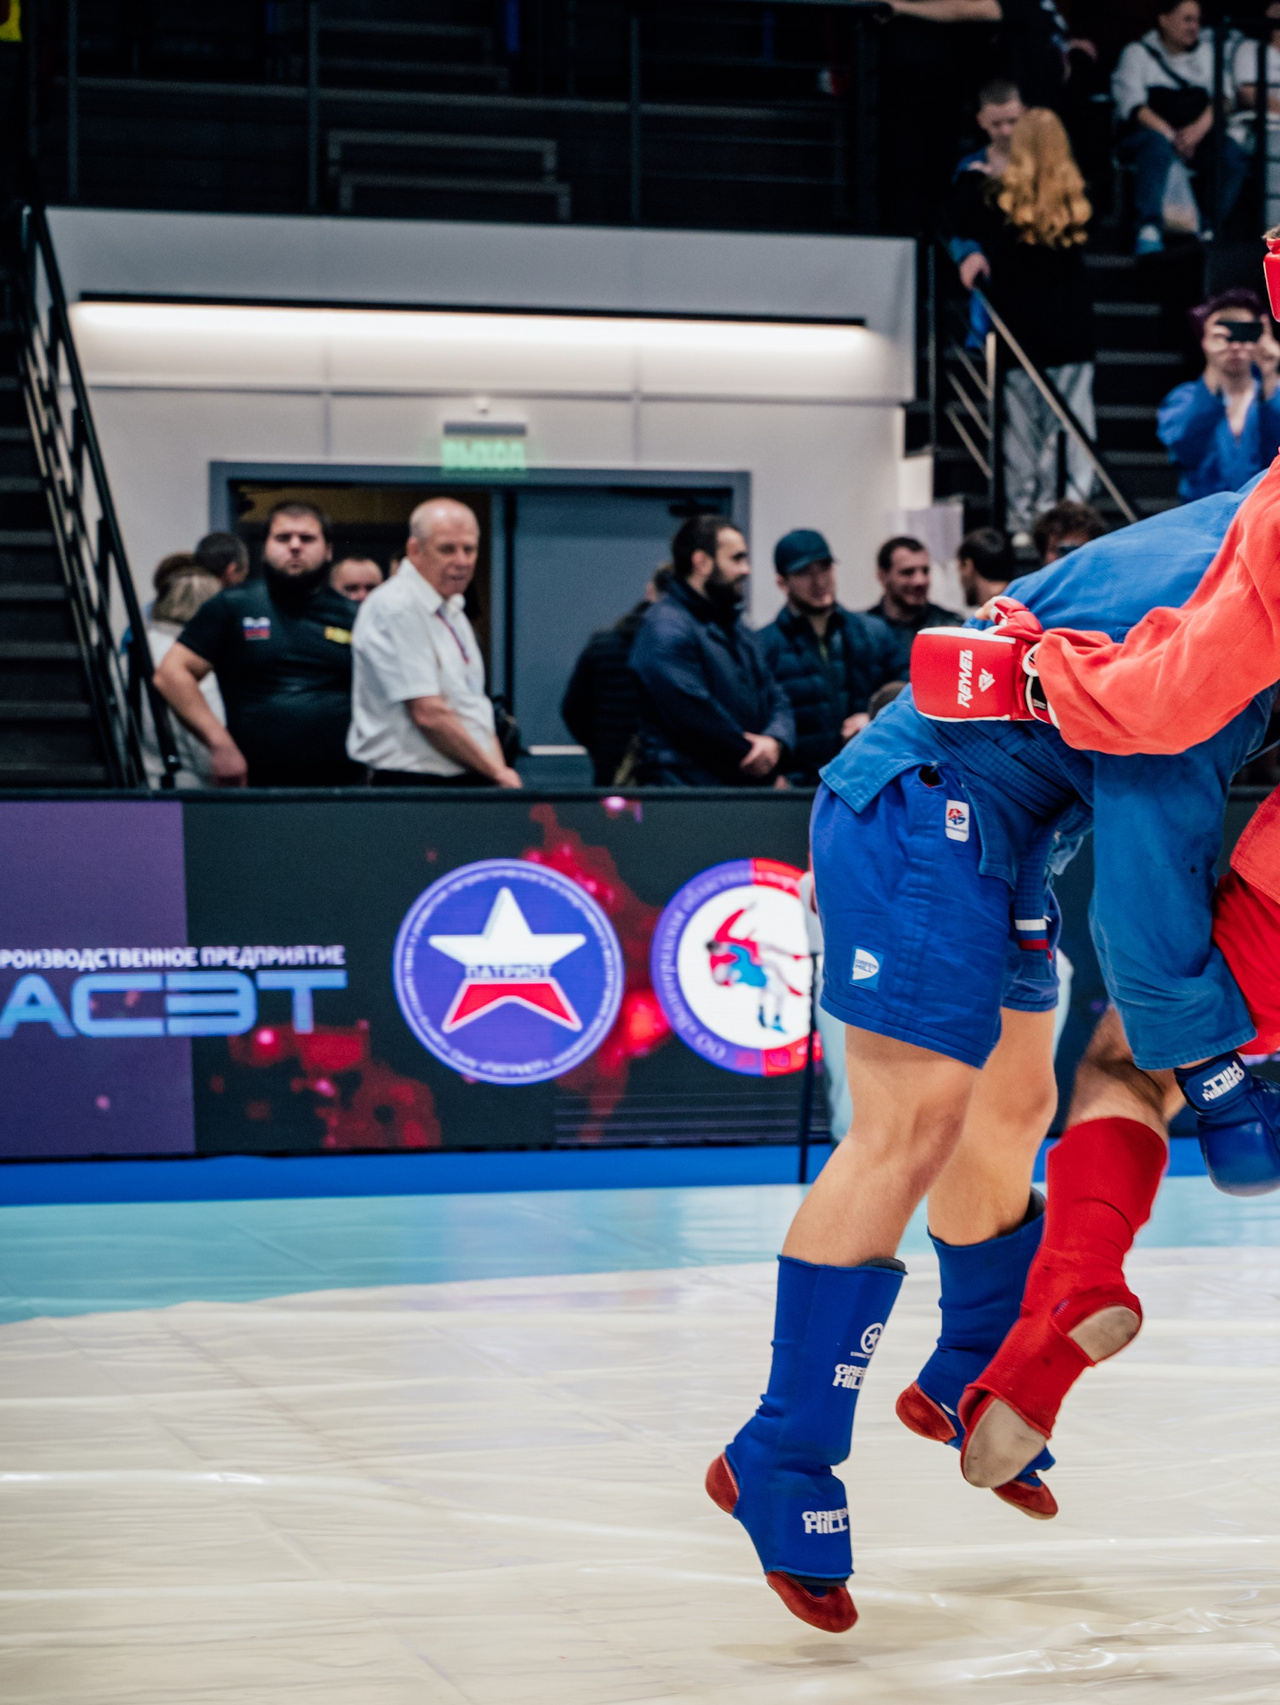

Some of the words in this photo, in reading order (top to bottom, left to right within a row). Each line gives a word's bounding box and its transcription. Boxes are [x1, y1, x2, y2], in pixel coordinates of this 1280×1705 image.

[200, 945, 346, 969] ПРЕДПРИЯТИЕ
[834, 1363, 867, 1377] GRE
[805, 1518, 848, 1534] HILL
